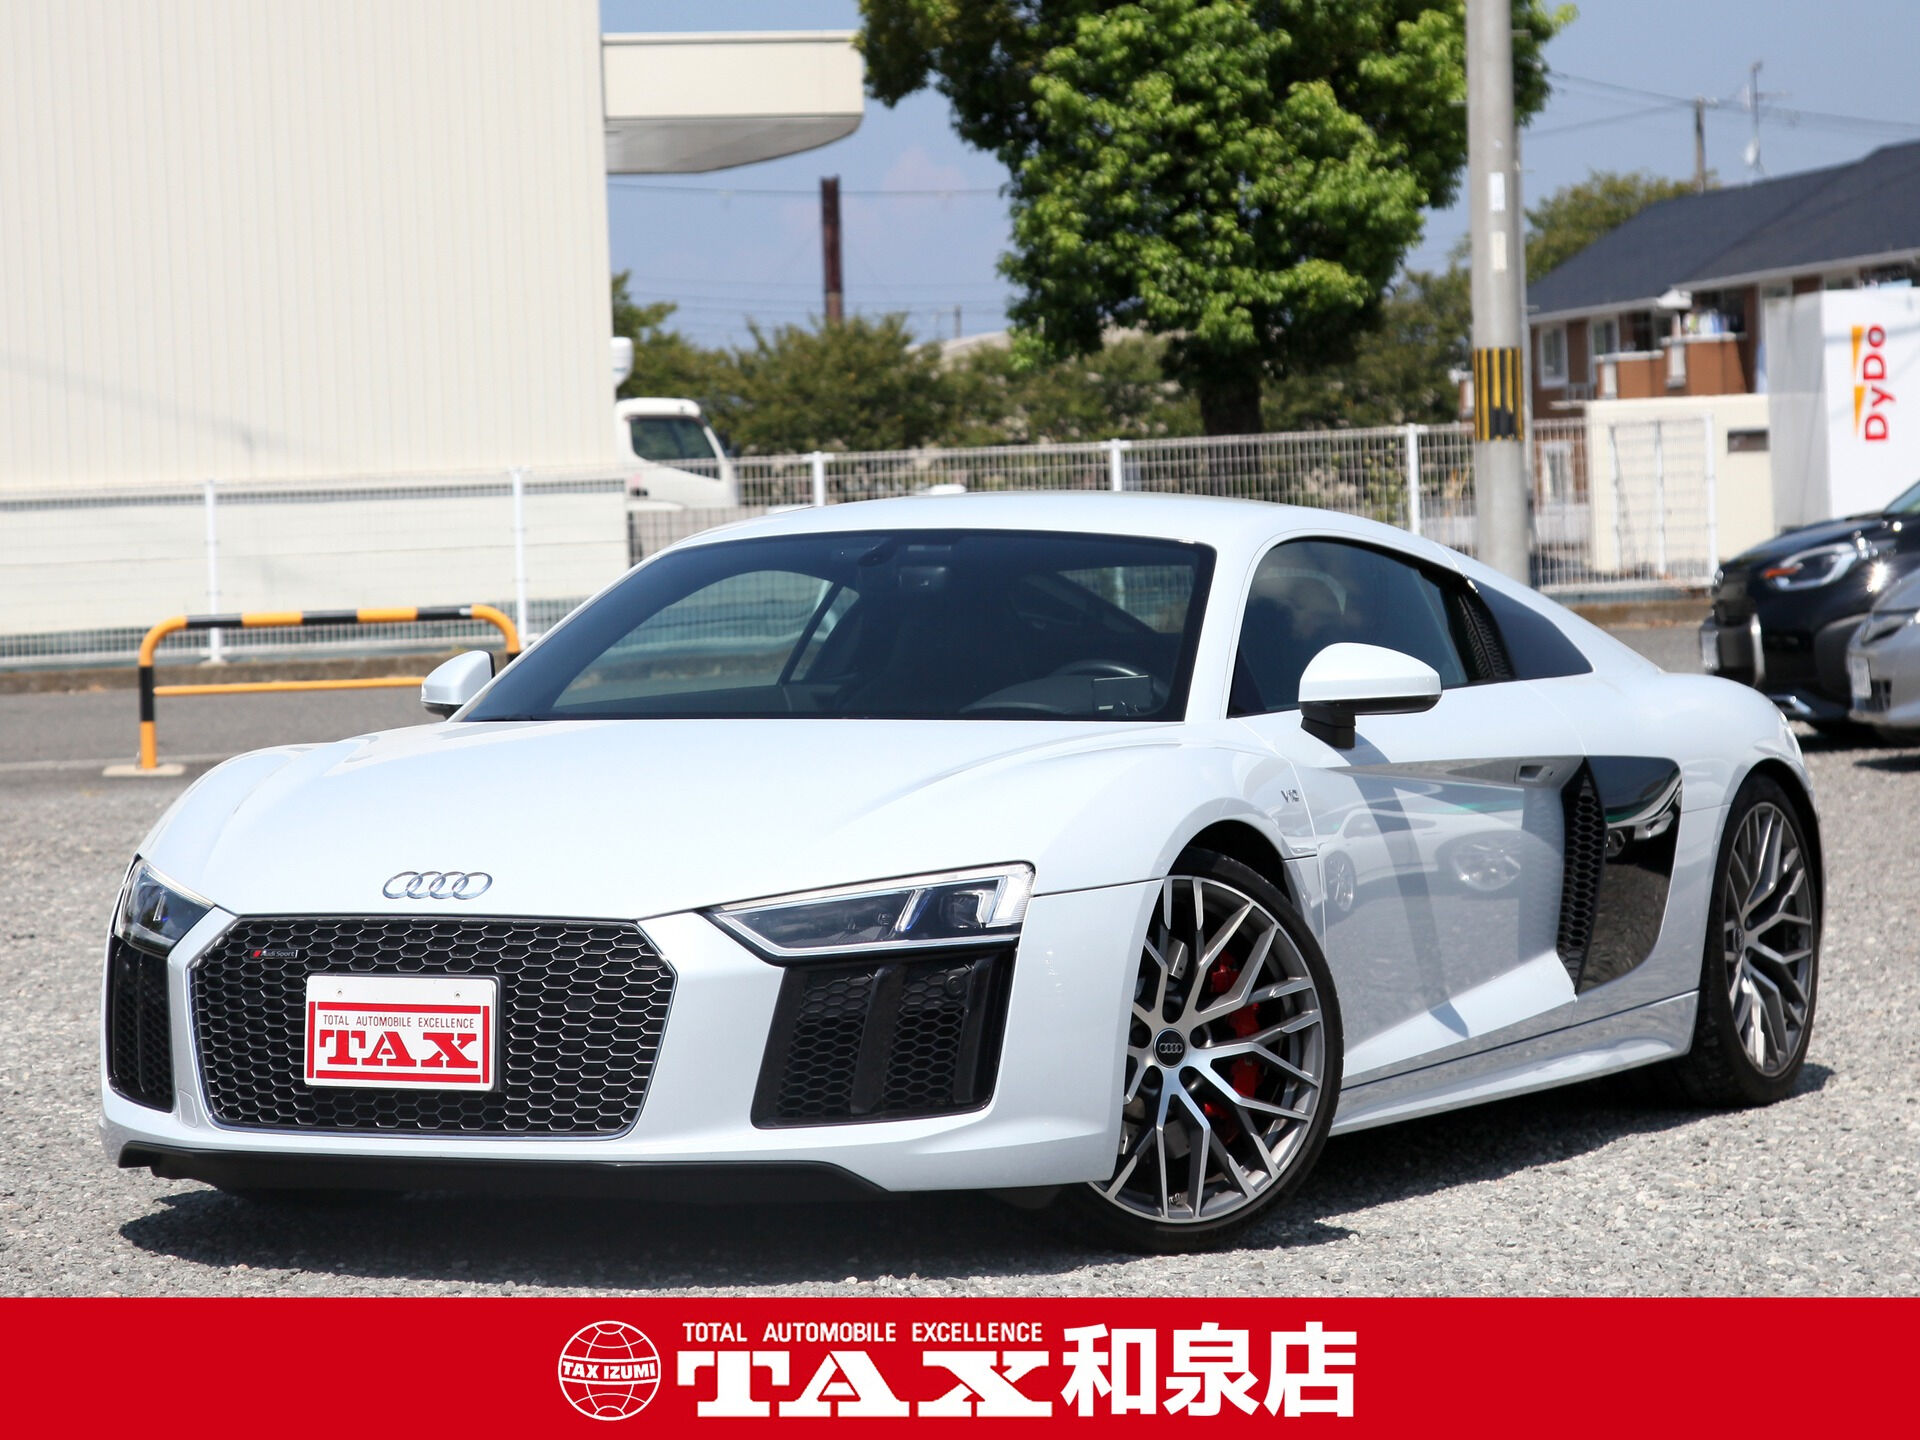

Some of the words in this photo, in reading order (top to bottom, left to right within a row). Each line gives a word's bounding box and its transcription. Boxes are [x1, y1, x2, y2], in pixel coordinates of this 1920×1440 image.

[1863, 325, 1895, 440] DyDo
[276, 950, 295, 958] Sport
[323, 1014, 349, 1026] TOTAL
[356, 1015, 412, 1028] AUTOMOBILE
[418, 1017, 475, 1029] EXCELLENCE
[319, 1029, 479, 1069] TAX
